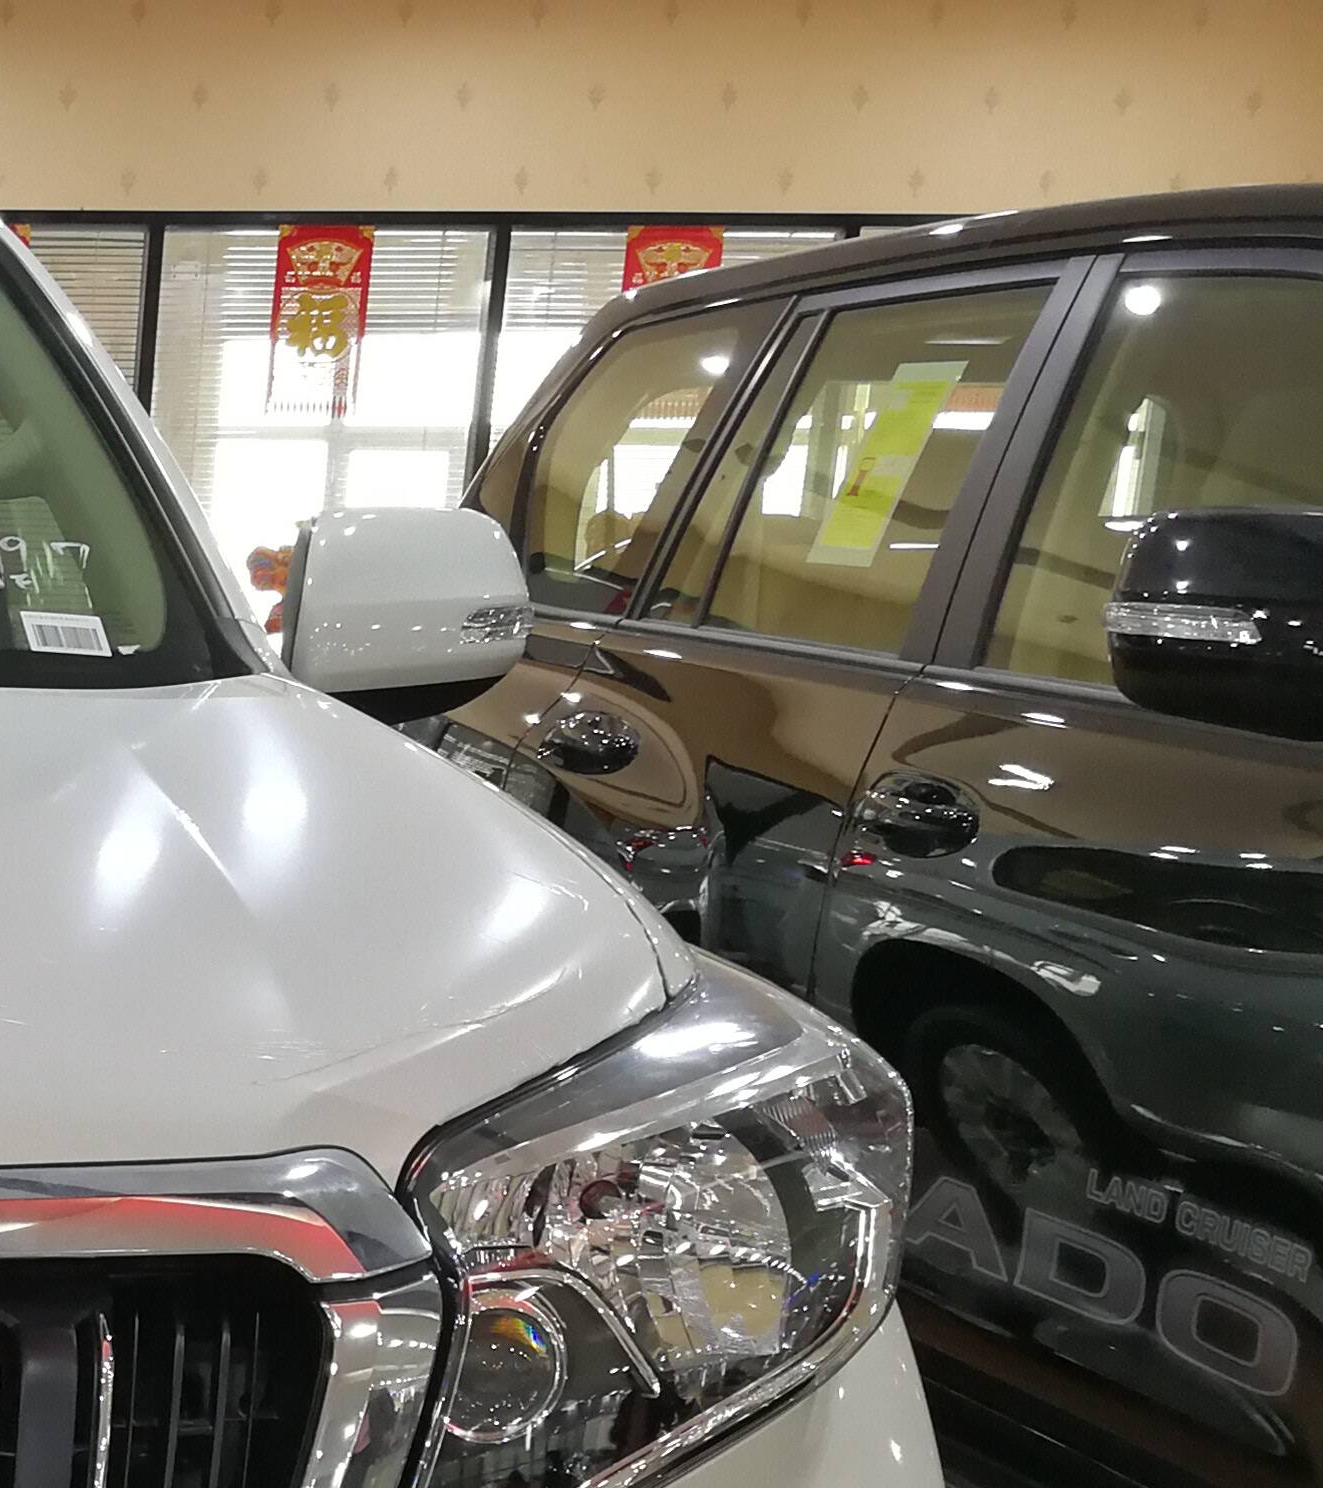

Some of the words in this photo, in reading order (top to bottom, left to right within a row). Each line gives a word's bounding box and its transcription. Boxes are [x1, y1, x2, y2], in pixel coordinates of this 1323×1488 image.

[285, 292, 349, 359] 福
[1086, 1167, 1170, 1224] LAND
[1175, 1200, 1313, 1283] CRUISER
